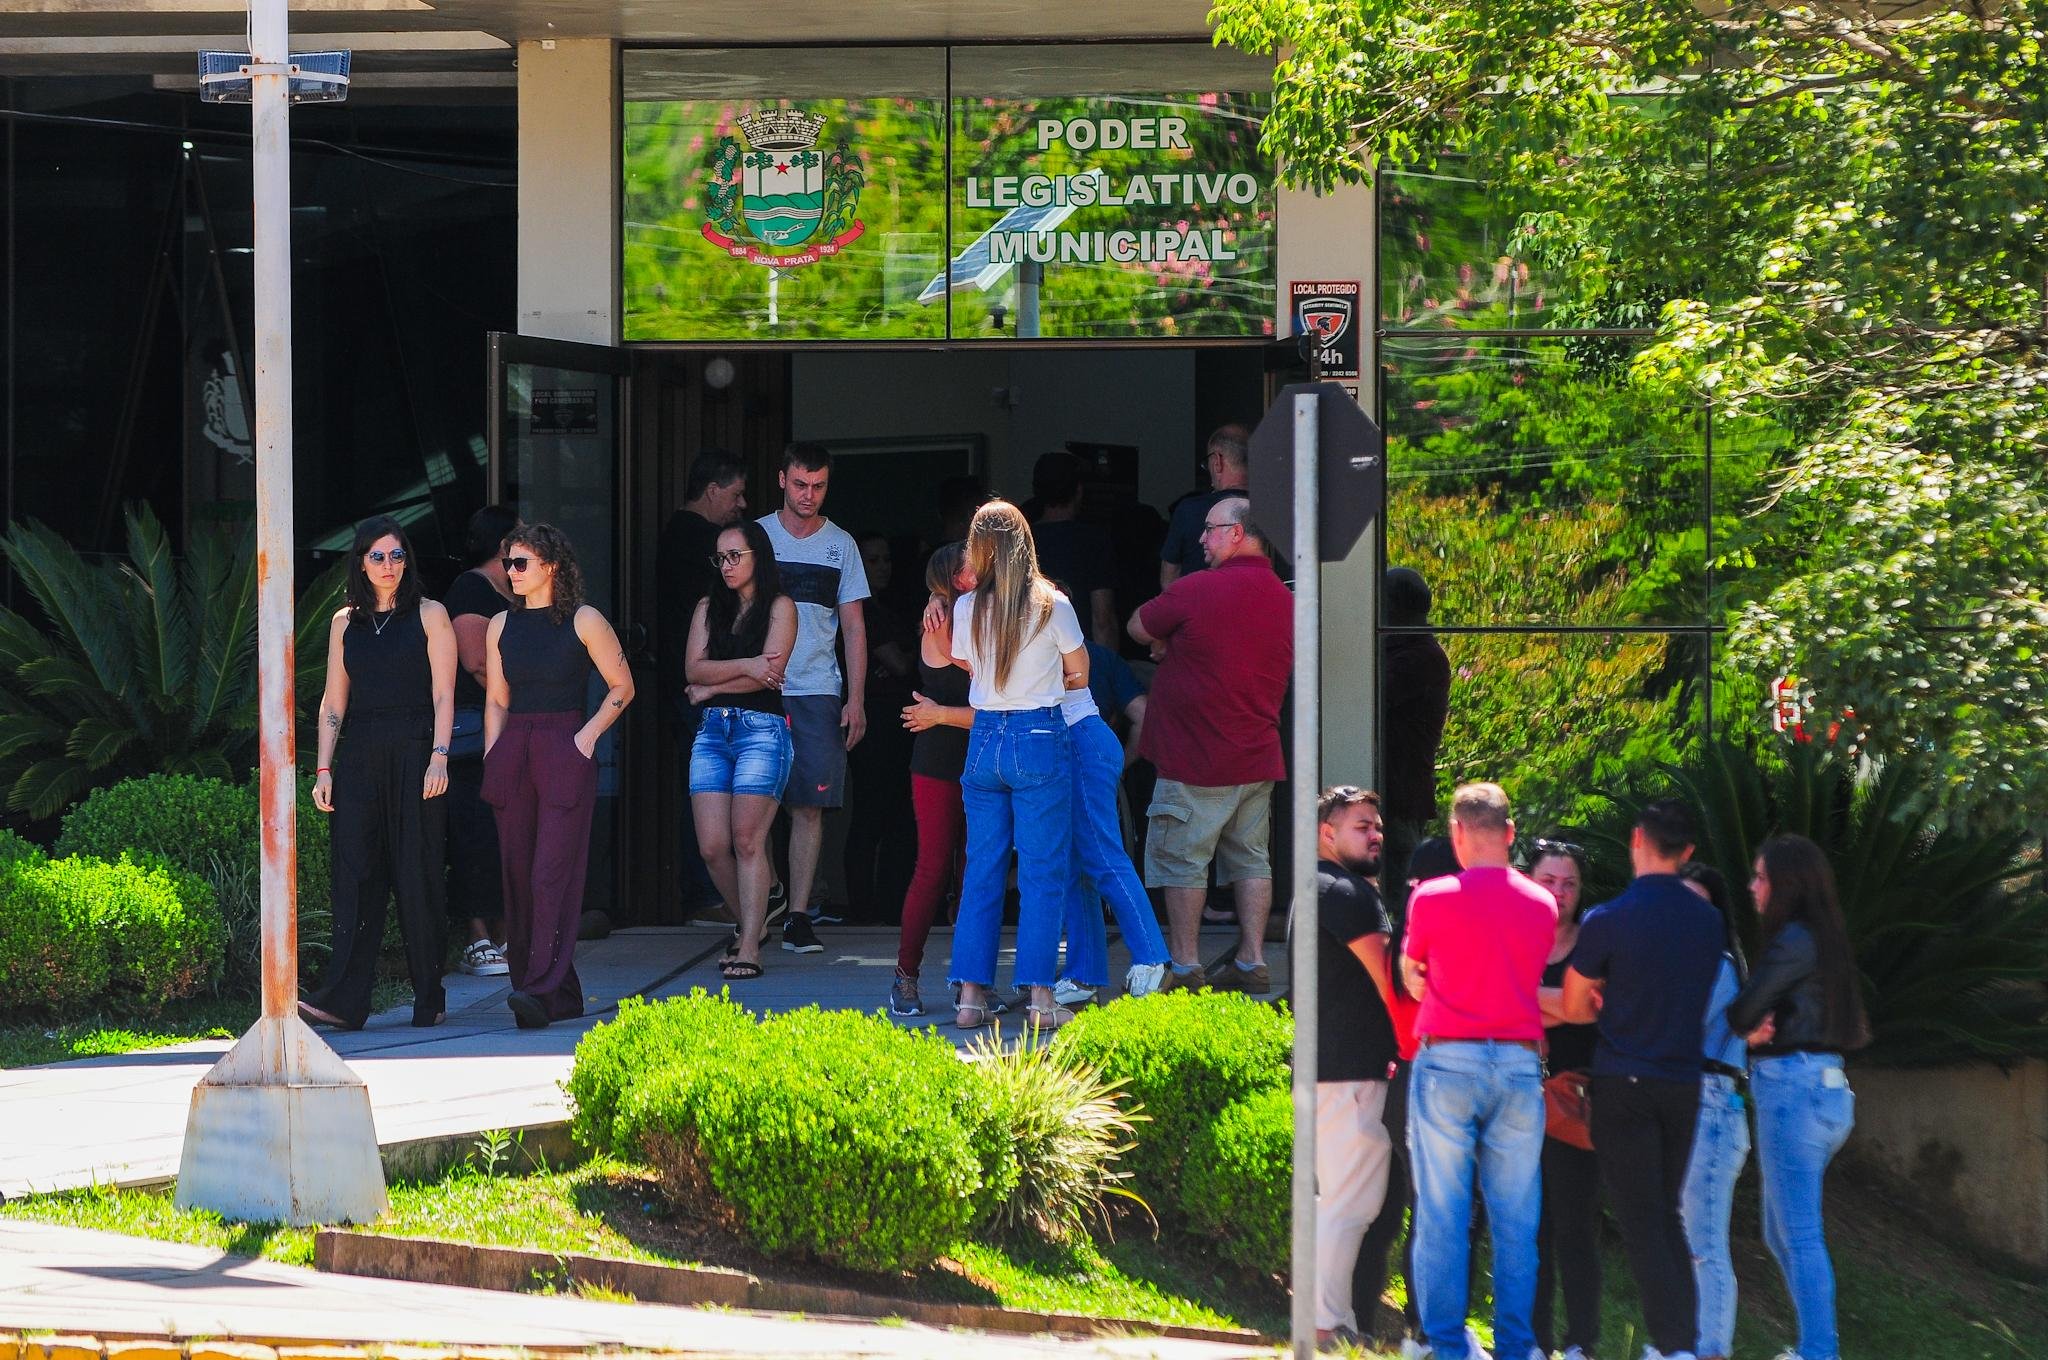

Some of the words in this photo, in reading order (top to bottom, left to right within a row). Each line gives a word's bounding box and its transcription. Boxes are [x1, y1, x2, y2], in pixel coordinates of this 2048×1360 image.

[1038, 117, 1191, 150] PODER
[966, 173, 1258, 208] LEGISLATIVO
[819, 245, 835, 253] 1924
[989, 229, 1236, 263] MUNICIPAL
[753, 255, 780, 266] NOVA
[784, 254, 815, 265] PRATA
[1293, 284, 1317, 295] LOCAL
[1317, 284, 1357, 295] PROTEGIDO
[1320, 348, 1343, 365] 4h
